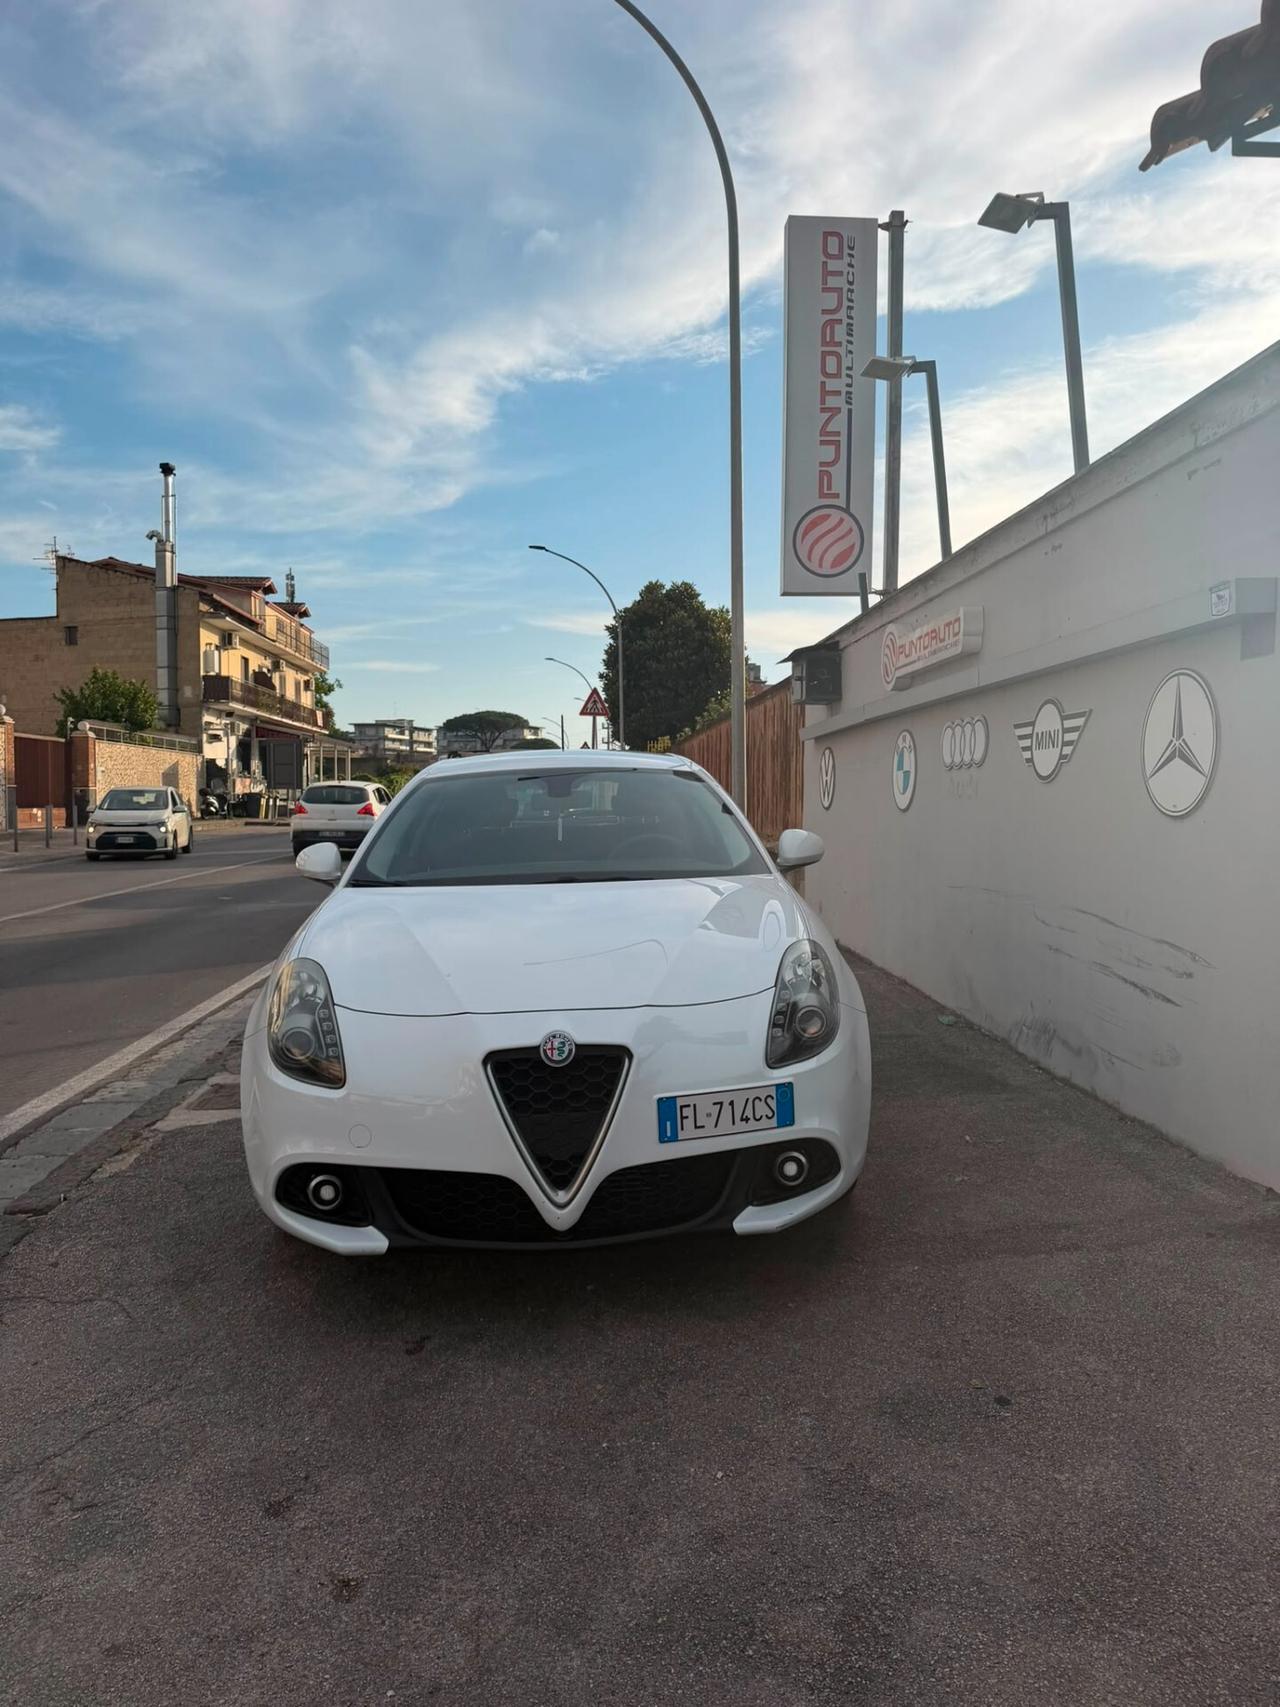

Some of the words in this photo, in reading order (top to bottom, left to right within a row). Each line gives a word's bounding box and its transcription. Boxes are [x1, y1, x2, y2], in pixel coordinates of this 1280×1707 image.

[818, 230, 845, 500] PUNTOAUTO
[844, 234, 856, 406] MULTIMARCHE
[897, 616, 961, 661] PUNTOAUTO
[1034, 729, 1060, 751] MINI
